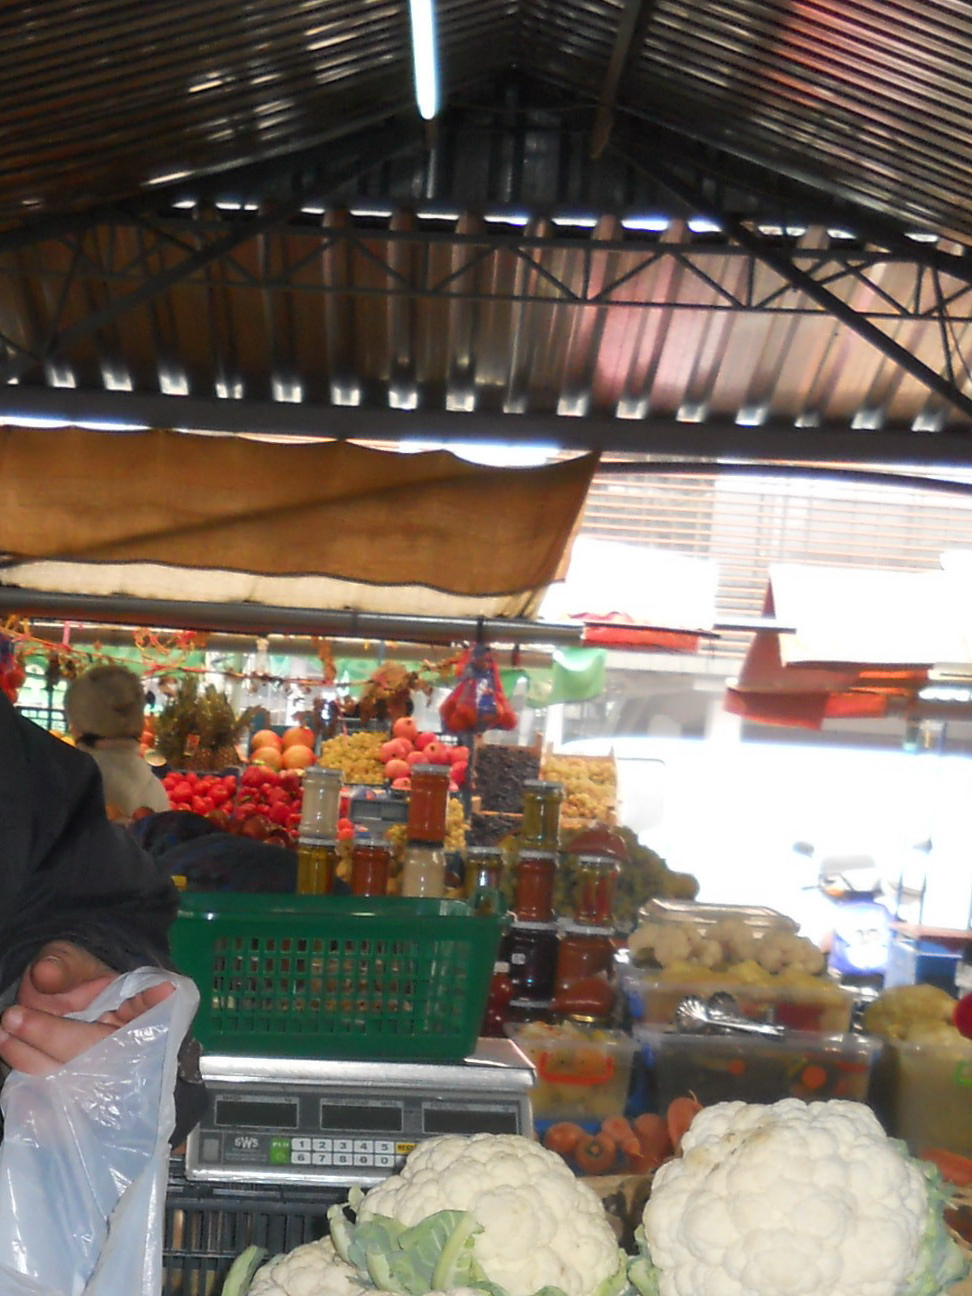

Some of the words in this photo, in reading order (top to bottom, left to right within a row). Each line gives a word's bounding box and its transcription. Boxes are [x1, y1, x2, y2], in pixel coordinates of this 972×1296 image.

[319, 1141, 326, 1149] 2
[360, 1142, 367, 1150] 4
[381, 1143, 388, 1151] 5
[339, 1155, 347, 1163] 8
